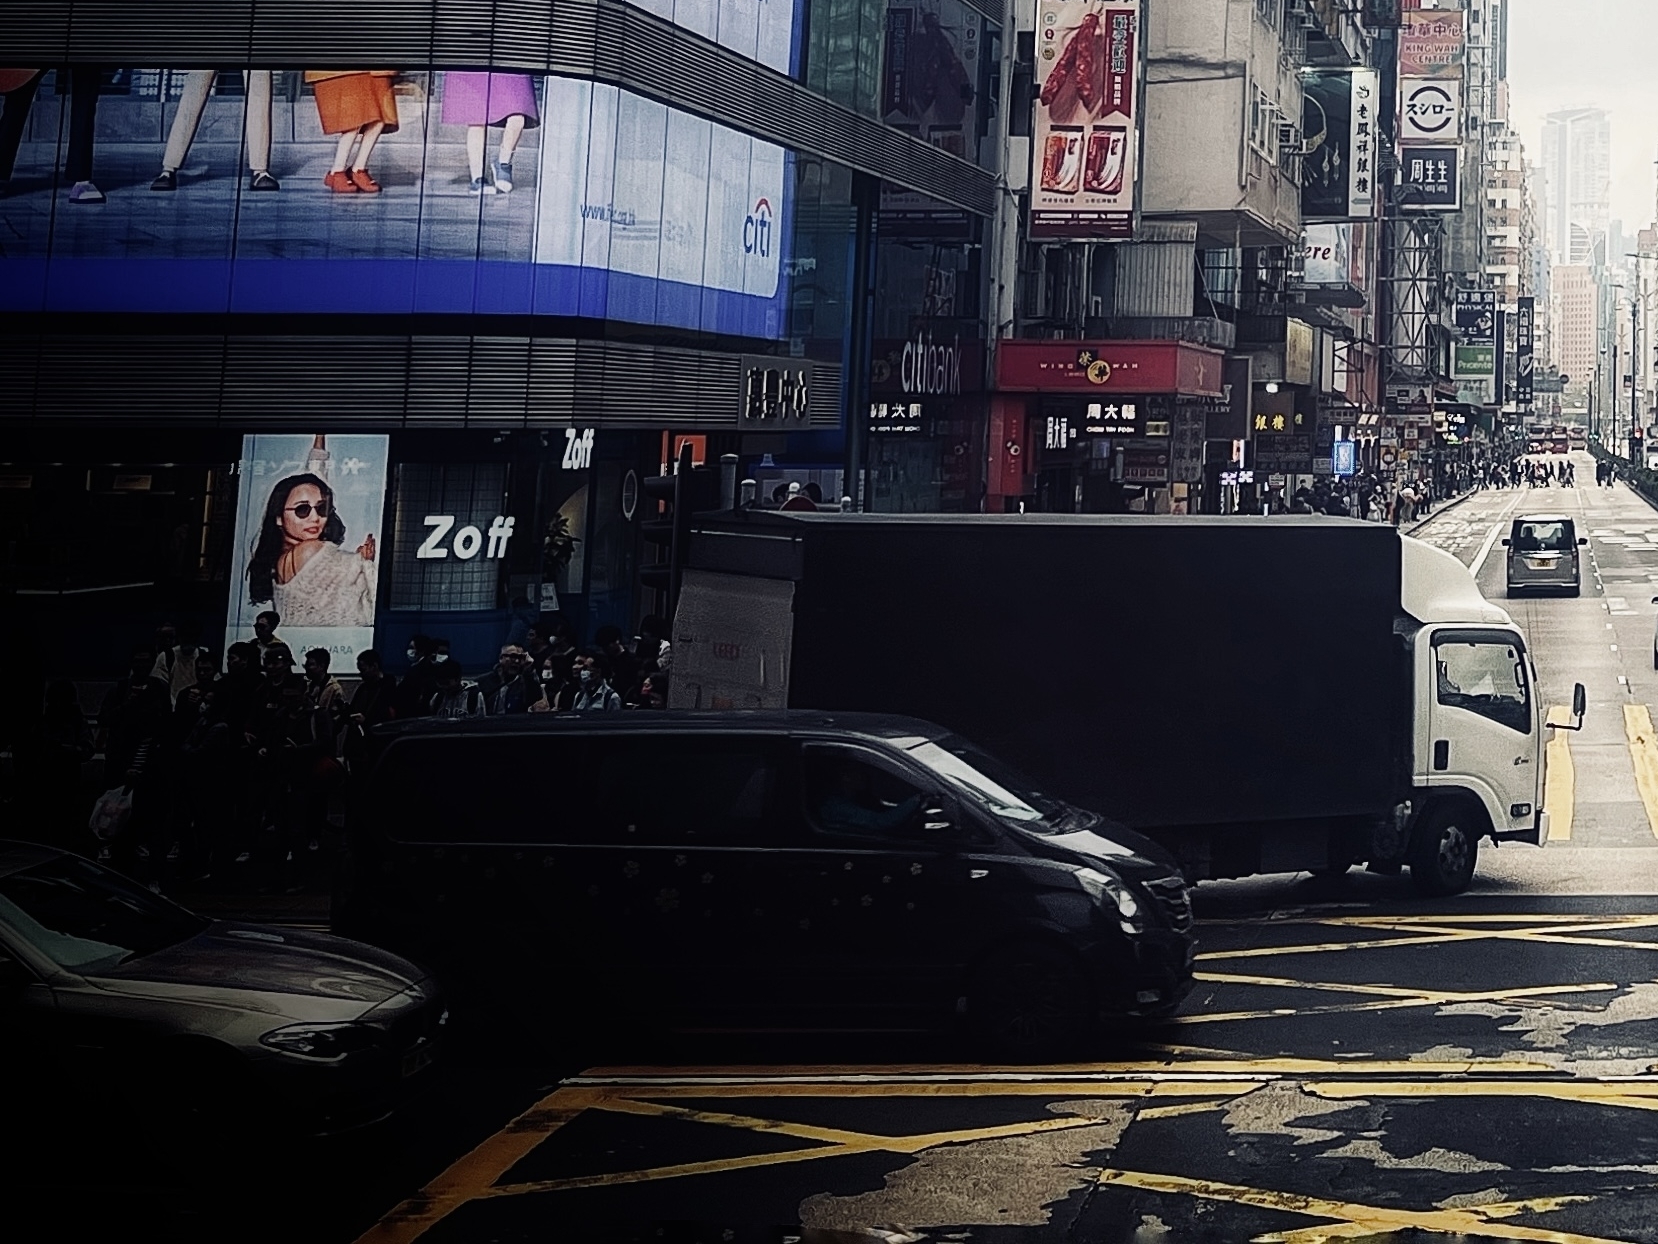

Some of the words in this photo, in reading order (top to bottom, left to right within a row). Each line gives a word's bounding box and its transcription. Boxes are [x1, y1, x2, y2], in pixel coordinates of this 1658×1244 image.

[1405, 44, 1430, 53] KING
[1434, 44, 1458, 53] WAH
[1412, 55, 1450, 64] CENTRE
[1405, 103, 1454, 116] スシロー
[1409, 159, 1448, 183] 周生生
[901, 330, 961, 395] citibank
[562, 428, 594, 470] Zoff
[416, 516, 515, 559] Zoff
